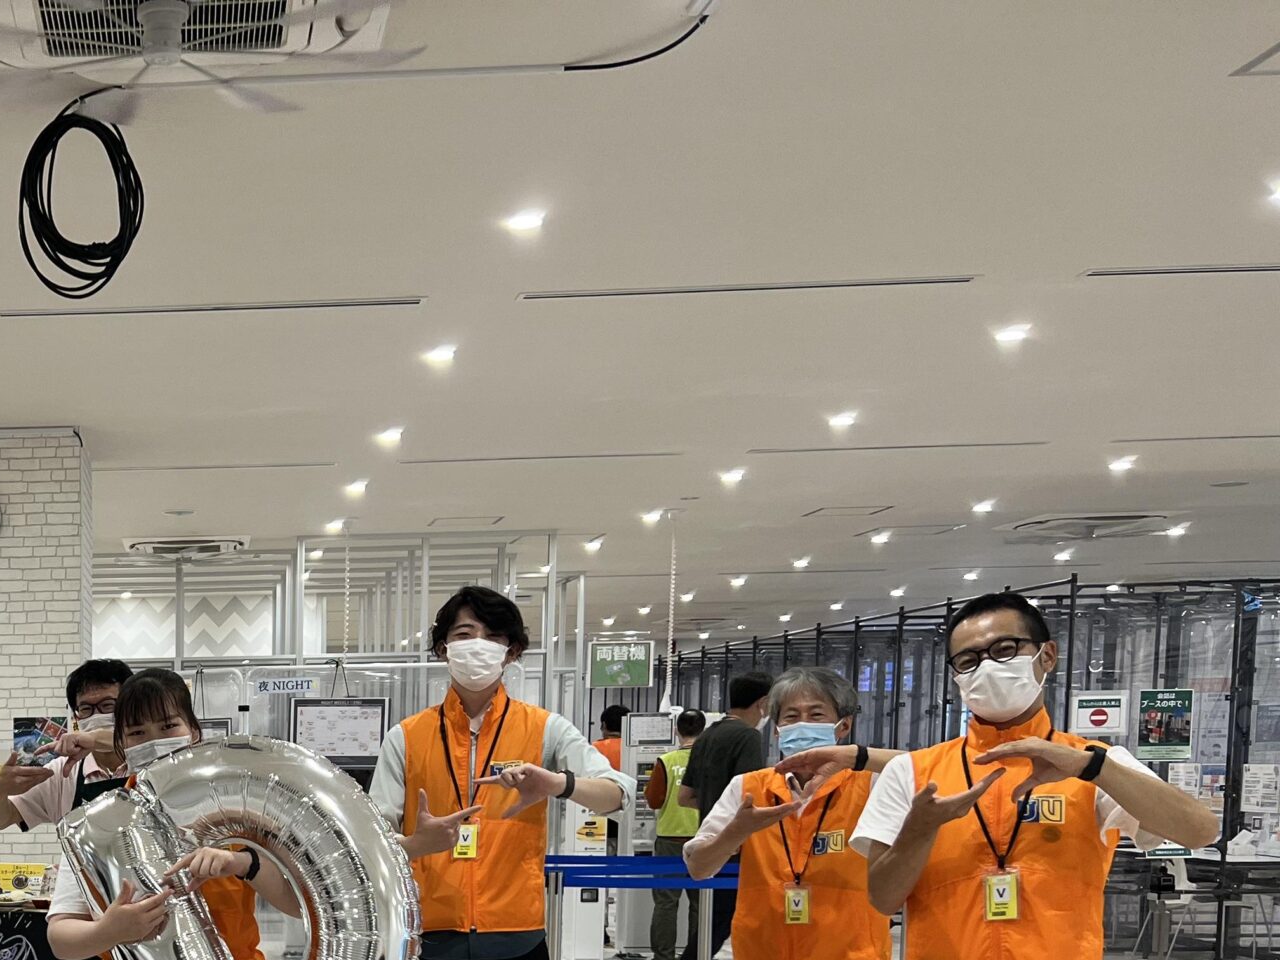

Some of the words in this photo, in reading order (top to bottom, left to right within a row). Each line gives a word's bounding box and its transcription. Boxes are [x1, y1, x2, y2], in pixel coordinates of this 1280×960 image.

[597, 644, 646, 661] 両替機
[259, 681, 268, 691] 夜
[273, 680, 312, 691] NIGHT
[672, 766, 687, 775] Tr
[996, 887, 1006, 898] V
[793, 899, 801, 907] V
